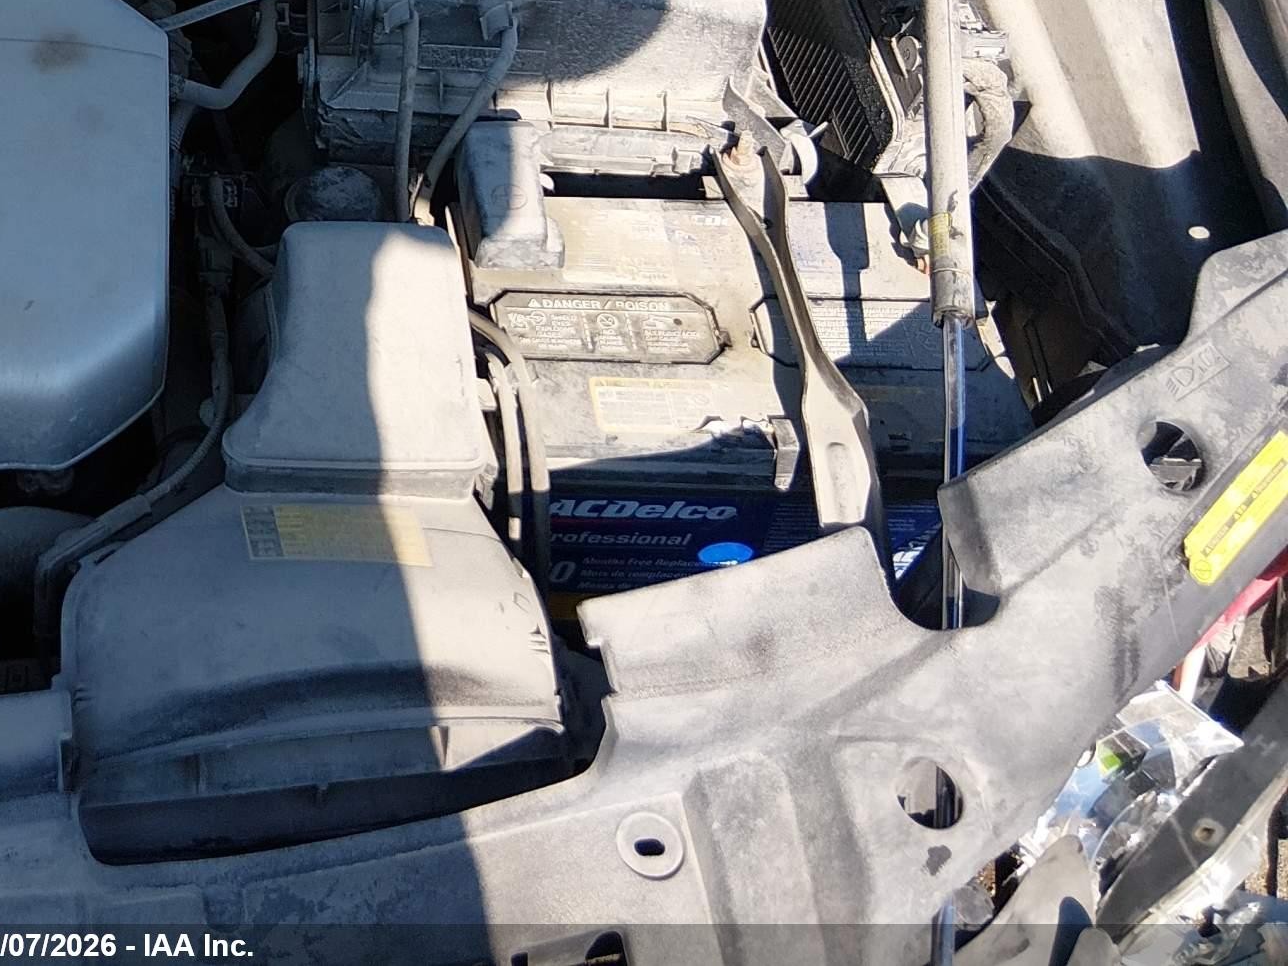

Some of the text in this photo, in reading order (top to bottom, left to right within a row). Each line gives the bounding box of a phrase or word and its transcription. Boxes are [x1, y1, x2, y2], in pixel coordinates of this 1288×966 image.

[542, 298, 601, 309] DANGER
[615, 300, 669, 311] POISON
[549, 499, 737, 520] ACDelco
[549, 531, 692, 546] rofessional
